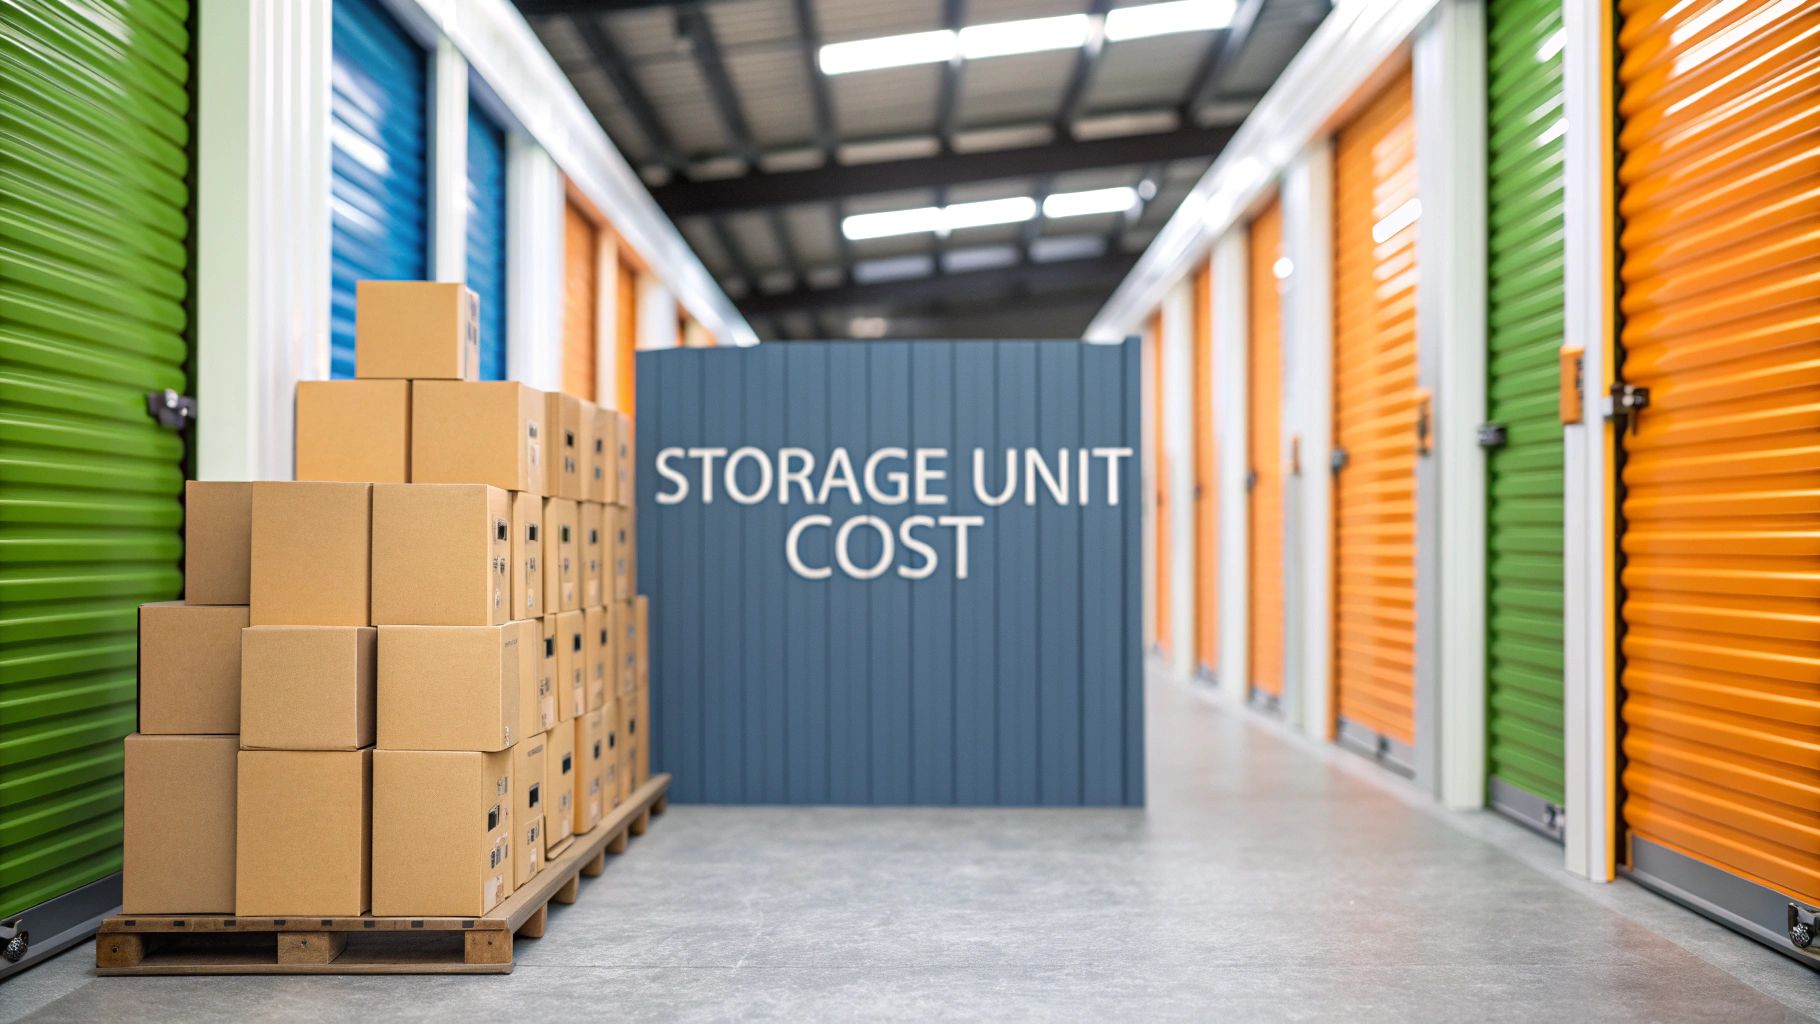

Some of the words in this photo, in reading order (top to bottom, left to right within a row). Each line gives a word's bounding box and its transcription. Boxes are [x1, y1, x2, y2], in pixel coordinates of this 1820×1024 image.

[655, 446, 948, 505] STORAGE
[972, 446, 1133, 506] UNIT
[785, 514, 985, 579] COST
